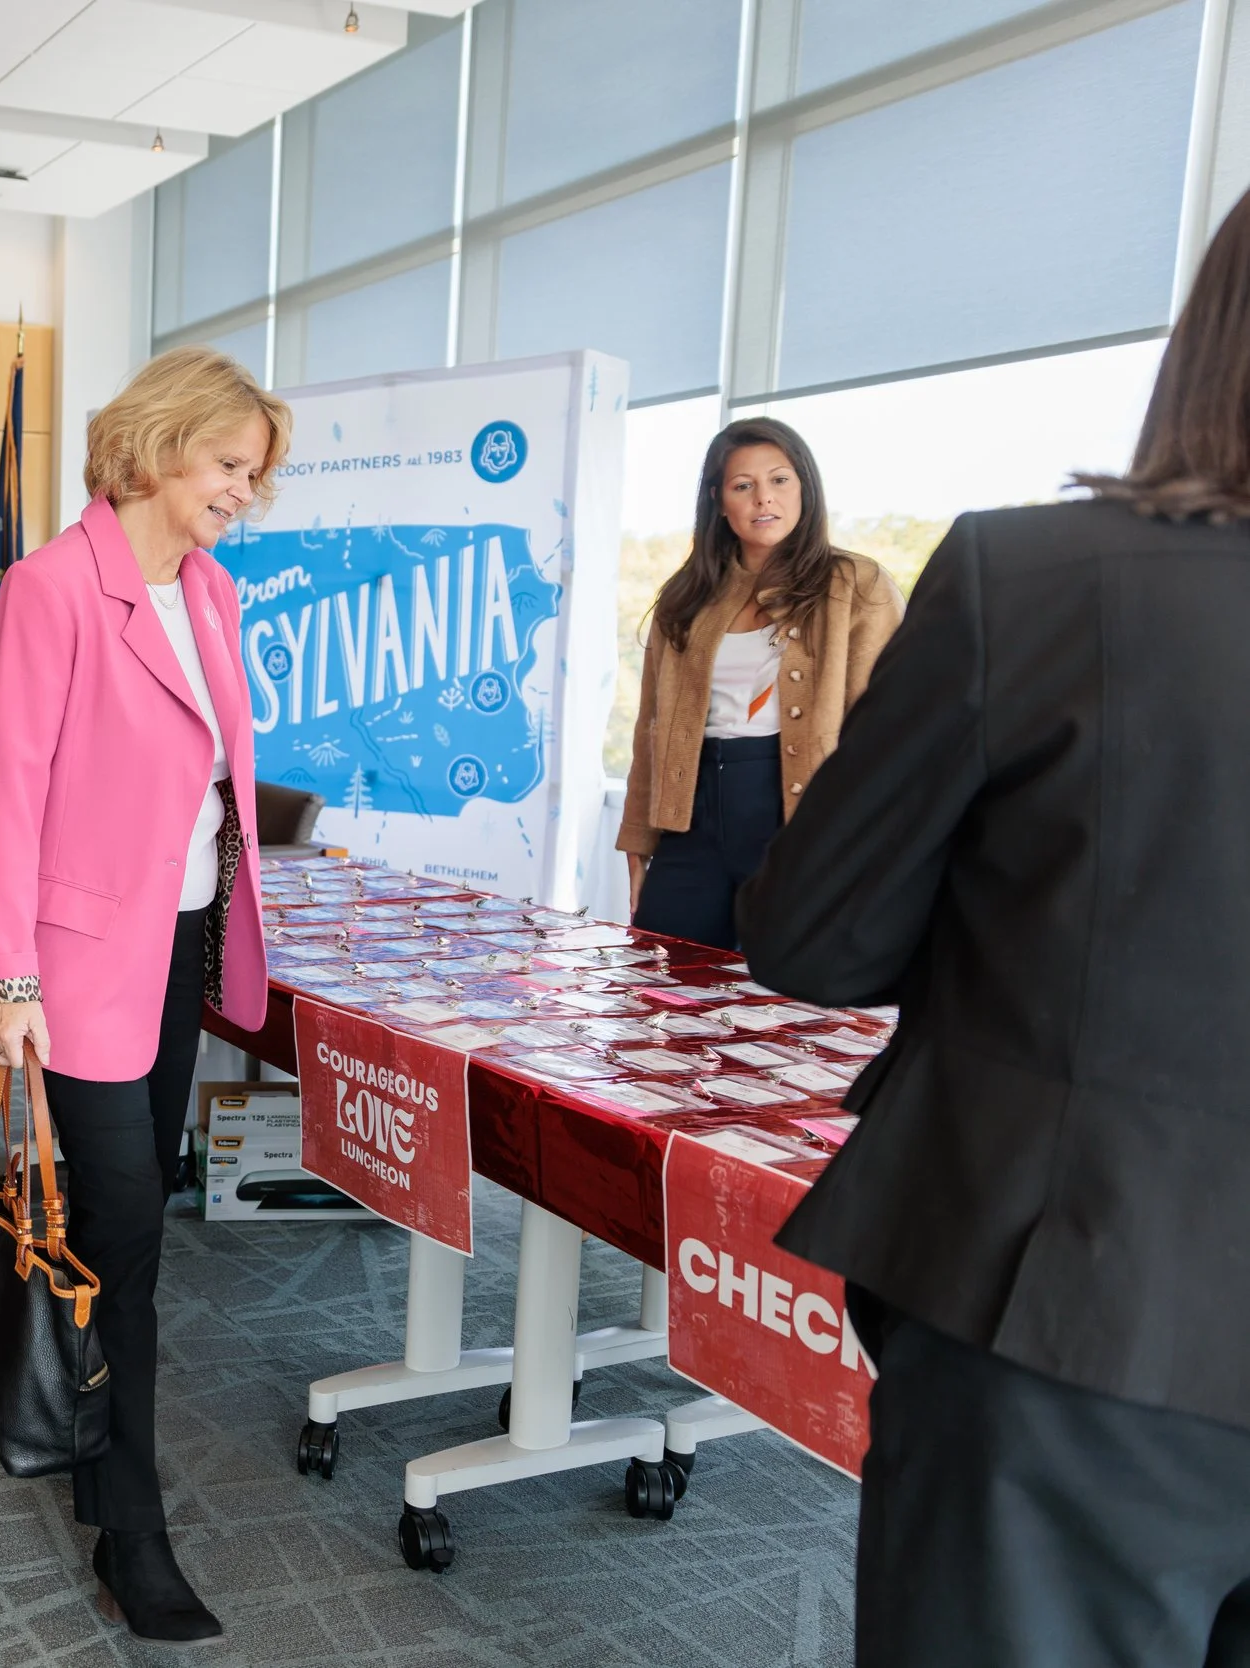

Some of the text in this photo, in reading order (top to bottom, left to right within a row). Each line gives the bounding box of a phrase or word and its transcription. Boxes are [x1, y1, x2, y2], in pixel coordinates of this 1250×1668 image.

[321, 454, 401, 473] PARTNERS
[427, 450, 463, 465] 1983
[424, 864, 498, 881] BETHLEHEM
[316, 1042, 439, 1112] COURAGEOUS
[217, 1114, 246, 1122] Spectra
[336, 1078, 416, 1164] LOVE
[264, 1151, 293, 1159] Spectra
[341, 1138, 410, 1192] LUNCHEON
